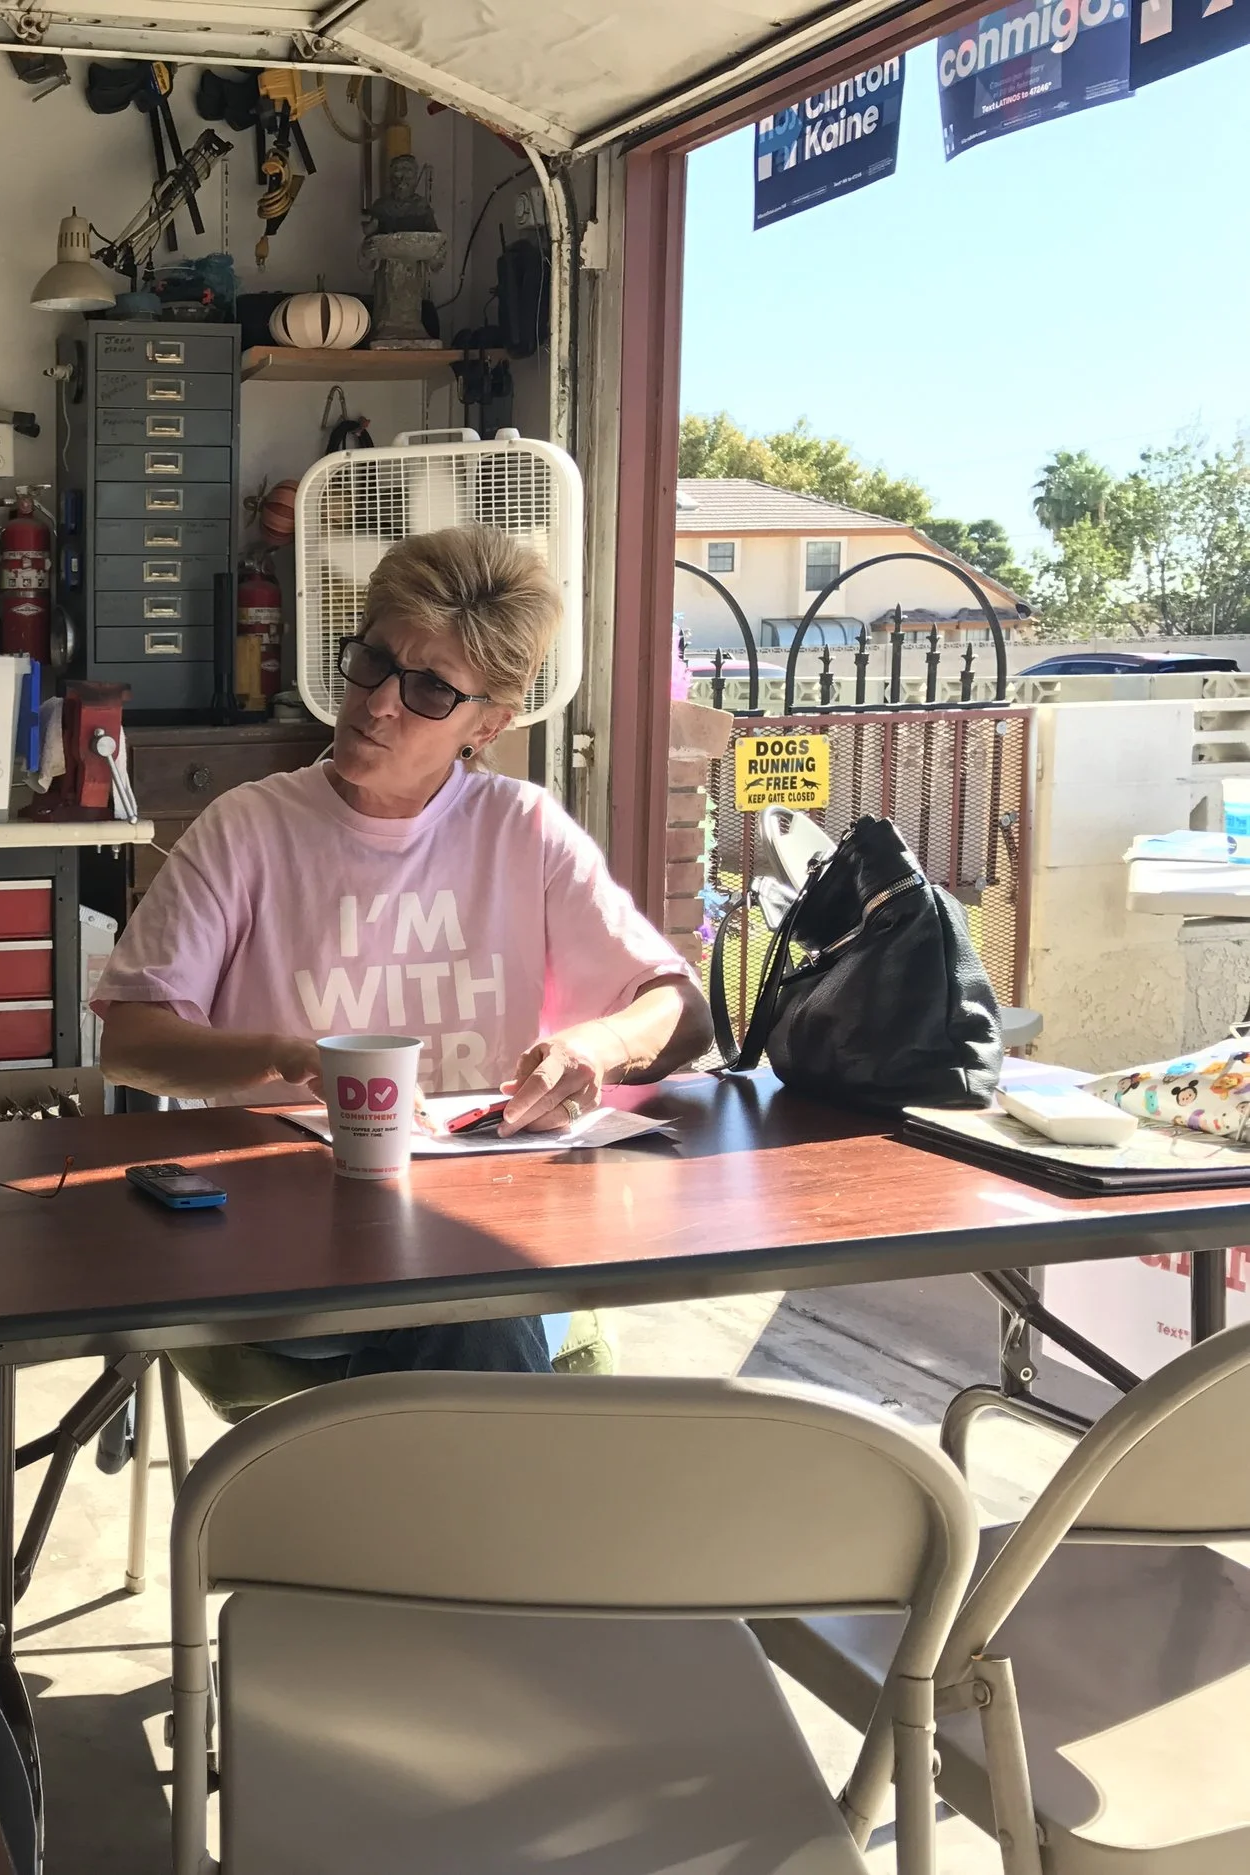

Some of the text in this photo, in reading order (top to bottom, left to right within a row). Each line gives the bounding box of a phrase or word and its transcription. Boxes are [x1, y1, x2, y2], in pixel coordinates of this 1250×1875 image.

[939, 0, 1125, 87] conmigo
[805, 56, 899, 119] Clinton
[995, 93, 1021, 109] LATINOS
[805, 105, 879, 160] Kaine
[756, 739, 810, 756] DOGS
[748, 757, 816, 775] RUNNING
[766, 776, 798, 791] FREE
[748, 791, 815, 804] KEEP GATE CLOSED
[339, 889, 467, 957] I'M
[294, 953, 506, 1031] WITH
[418, 1031, 491, 1094] ER
[340, 1113, 398, 1121] COMMITMENT
